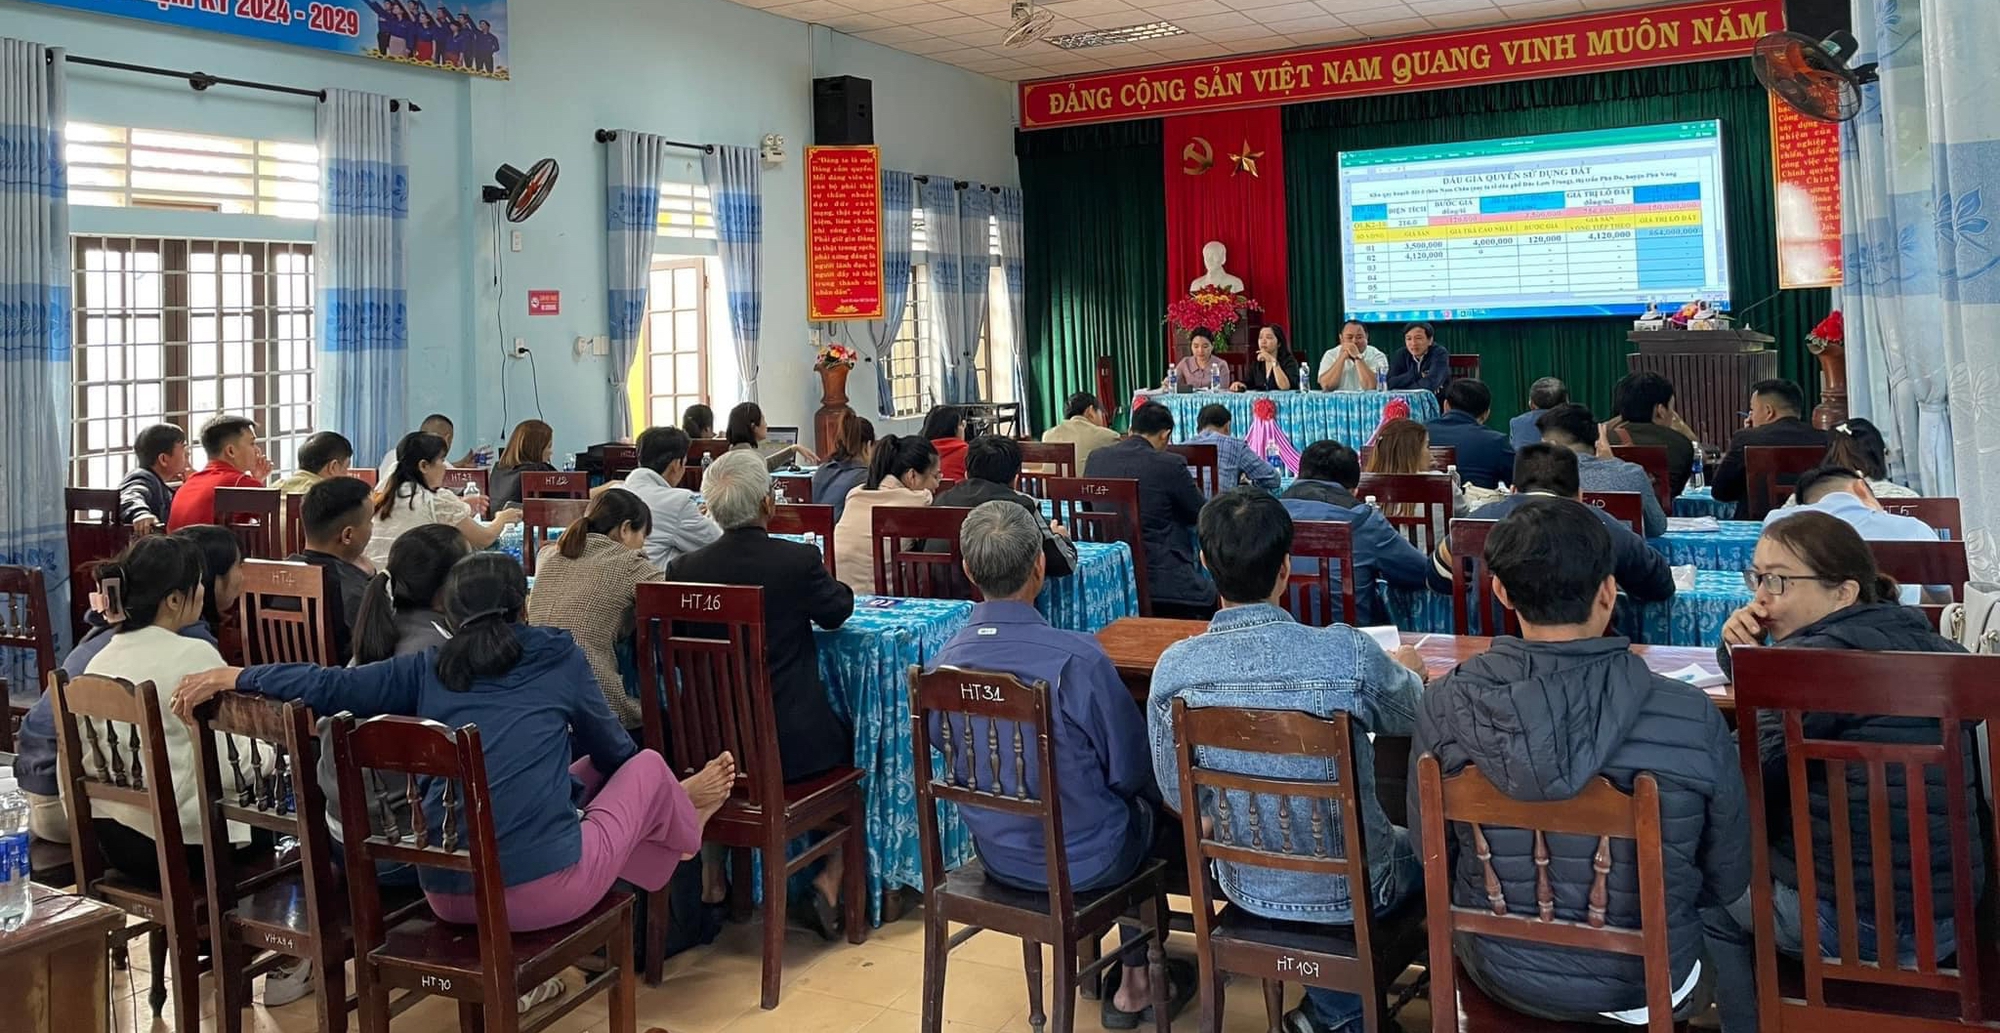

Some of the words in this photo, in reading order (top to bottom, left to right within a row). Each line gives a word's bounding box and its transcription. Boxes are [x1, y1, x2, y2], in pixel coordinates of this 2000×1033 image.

[235, 0, 290, 25] 2024
[308, 2, 359, 36] 2029
[1049, 83, 1113, 115] ĐẢNG
[1121, 77, 1185, 110] CỘNG
[1194, 66, 1243, 100] SẢN
[1250, 61, 1313, 94] VIỆT
[1322, 55, 1382, 85] NAM
[1392, 44, 1491, 83] QUANG
[1500, 32, 1577, 66] VINH
[1586, 18, 1680, 56] MUÔN
[1692, 8, 1768, 45] NĂM
